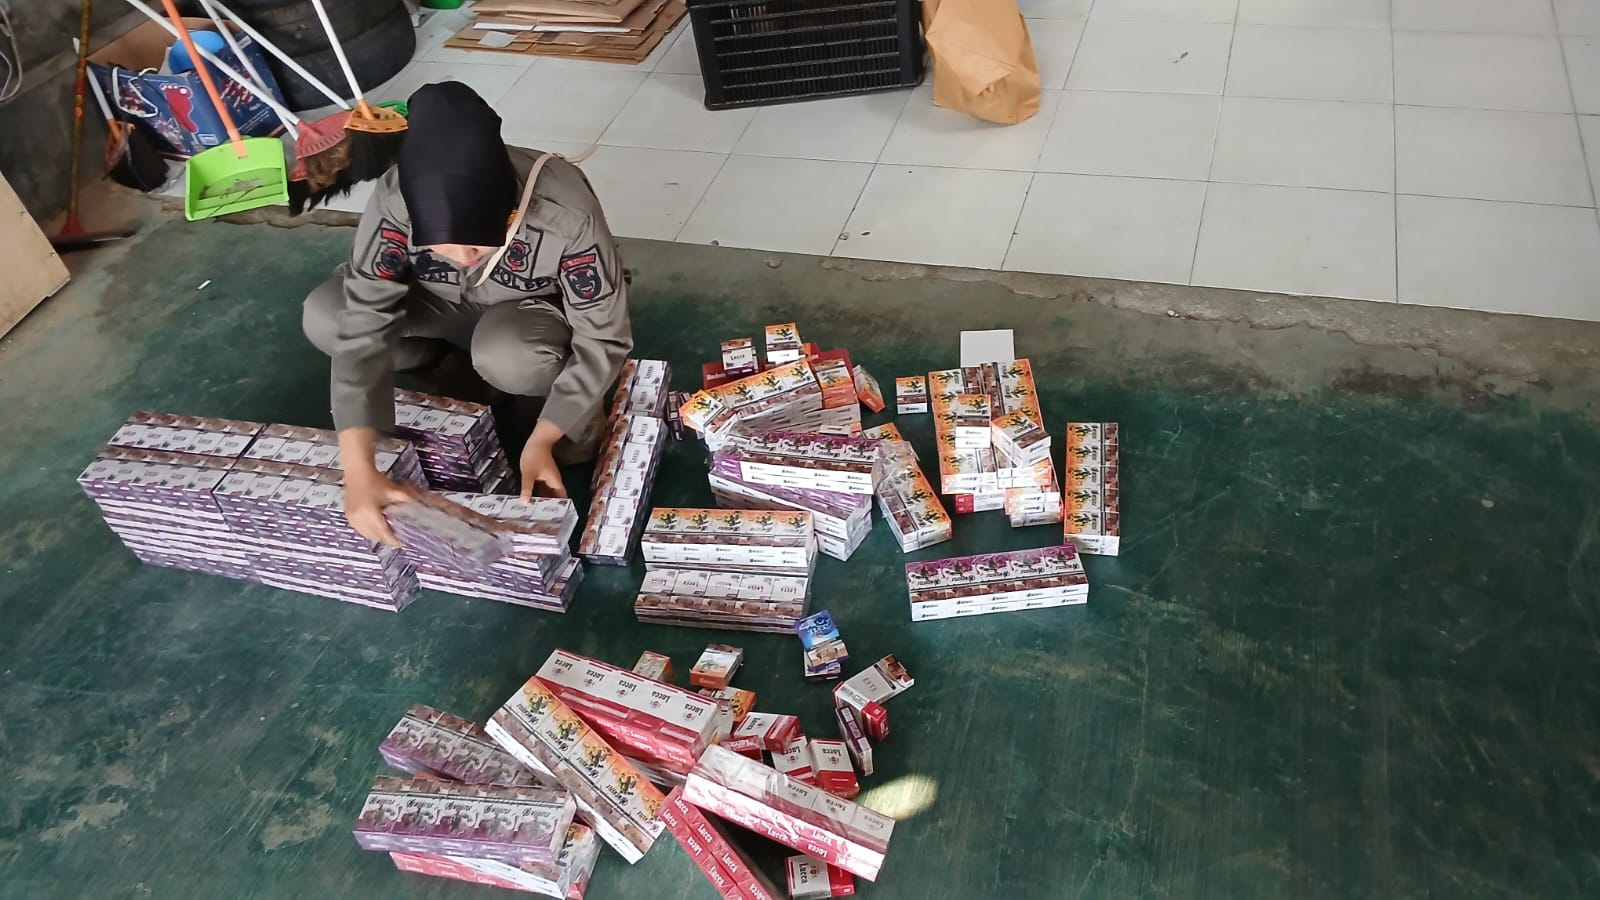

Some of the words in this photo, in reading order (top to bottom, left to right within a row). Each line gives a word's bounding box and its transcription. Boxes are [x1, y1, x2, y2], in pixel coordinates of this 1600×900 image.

[555, 658, 573, 672] Lucca
[586, 669, 605, 682] Lucca
[618, 679, 637, 692] Lucca
[651, 690, 671, 704] Lucca
[684, 702, 704, 717] Lucca
[746, 717, 761, 731] Lucca
[822, 747, 842, 756] Lucca
[674, 795, 689, 815] Lucca
[663, 808, 677, 827] Lucca
[698, 823, 713, 843] Lucca
[811, 829, 832, 845] Lucca
[687, 836, 702, 856] Lucca
[808, 844, 828, 858] Lucca
[722, 853, 737, 873] Lucca
[709, 866, 724, 887] Lucca
[799, 862, 808, 884] Lucca
